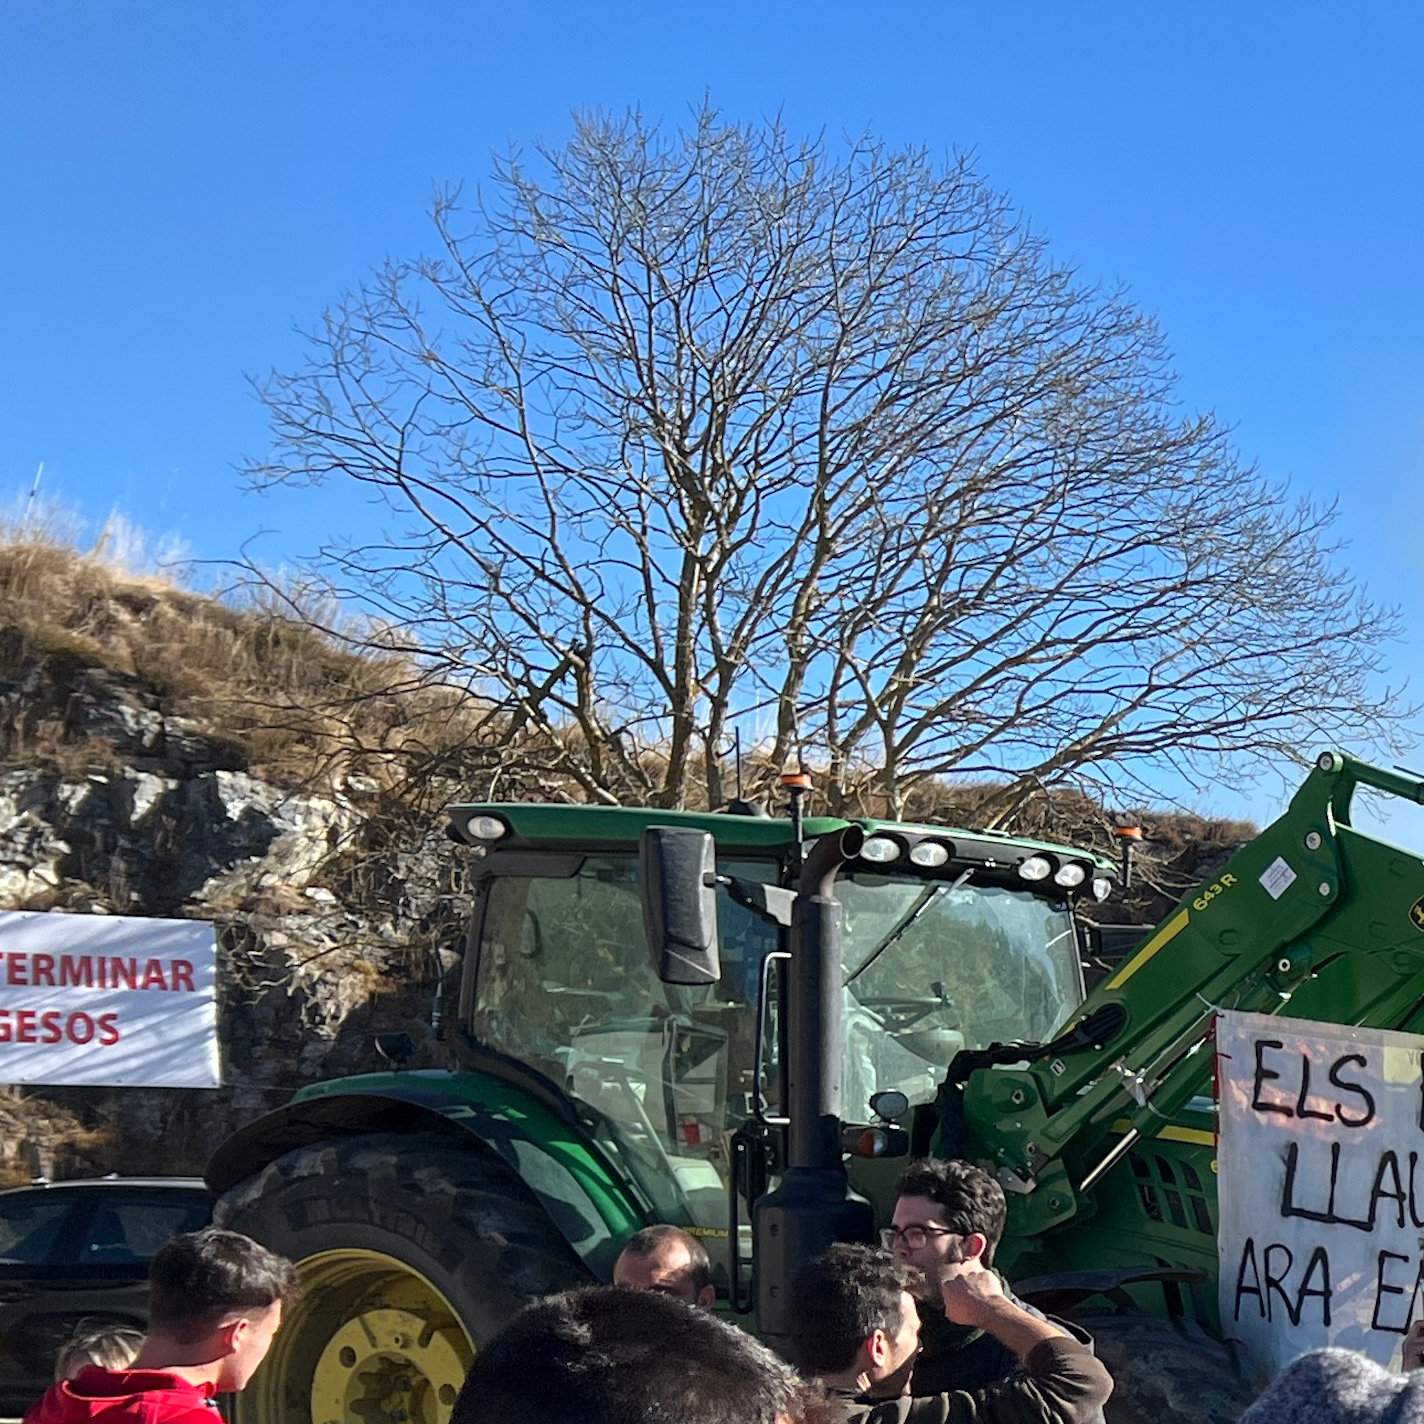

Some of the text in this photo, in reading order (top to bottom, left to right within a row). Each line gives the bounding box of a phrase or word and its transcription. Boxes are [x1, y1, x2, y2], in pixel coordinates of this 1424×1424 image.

[1193, 873, 1238, 911] 643 R
[0, 952, 196, 992] ERMINAR
[1252, 1040, 1376, 1127] ELS
[1234, 1237, 1333, 1327] ARA
